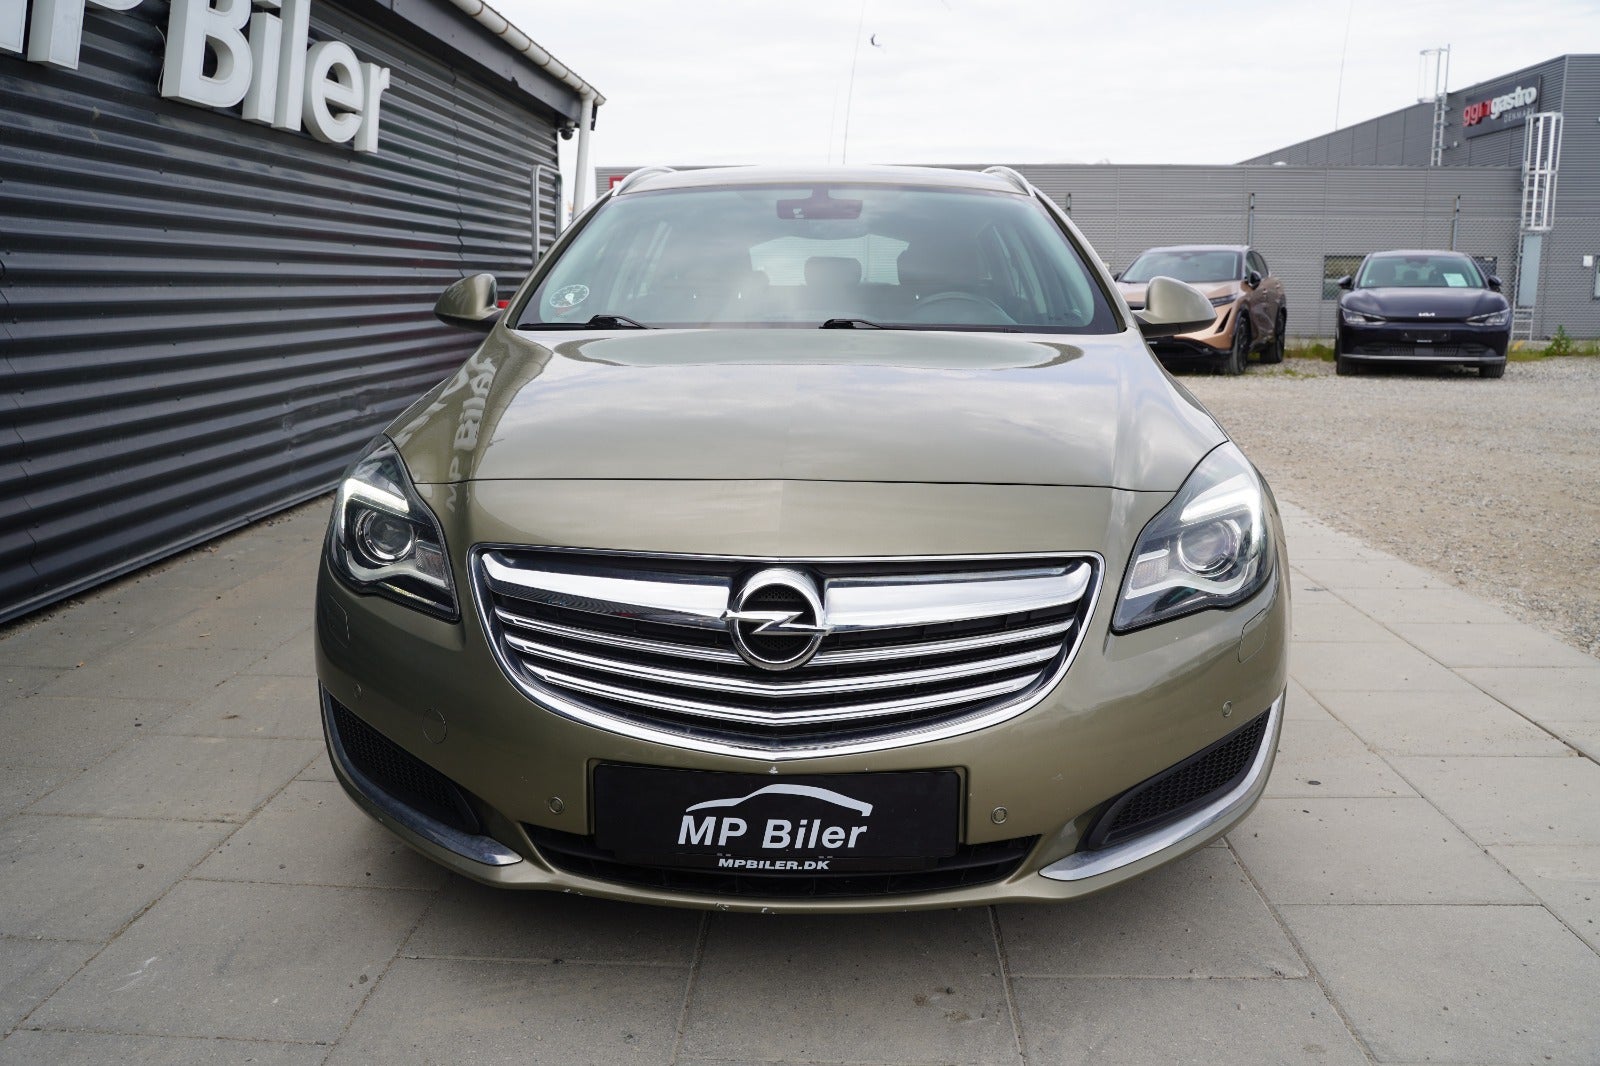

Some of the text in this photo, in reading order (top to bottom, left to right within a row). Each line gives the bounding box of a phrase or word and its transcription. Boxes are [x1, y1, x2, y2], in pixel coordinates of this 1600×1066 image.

[161, 0, 390, 154] Biler
[678, 815, 867, 848] MP Biler
[718, 858, 830, 870] MPBILER.DK
